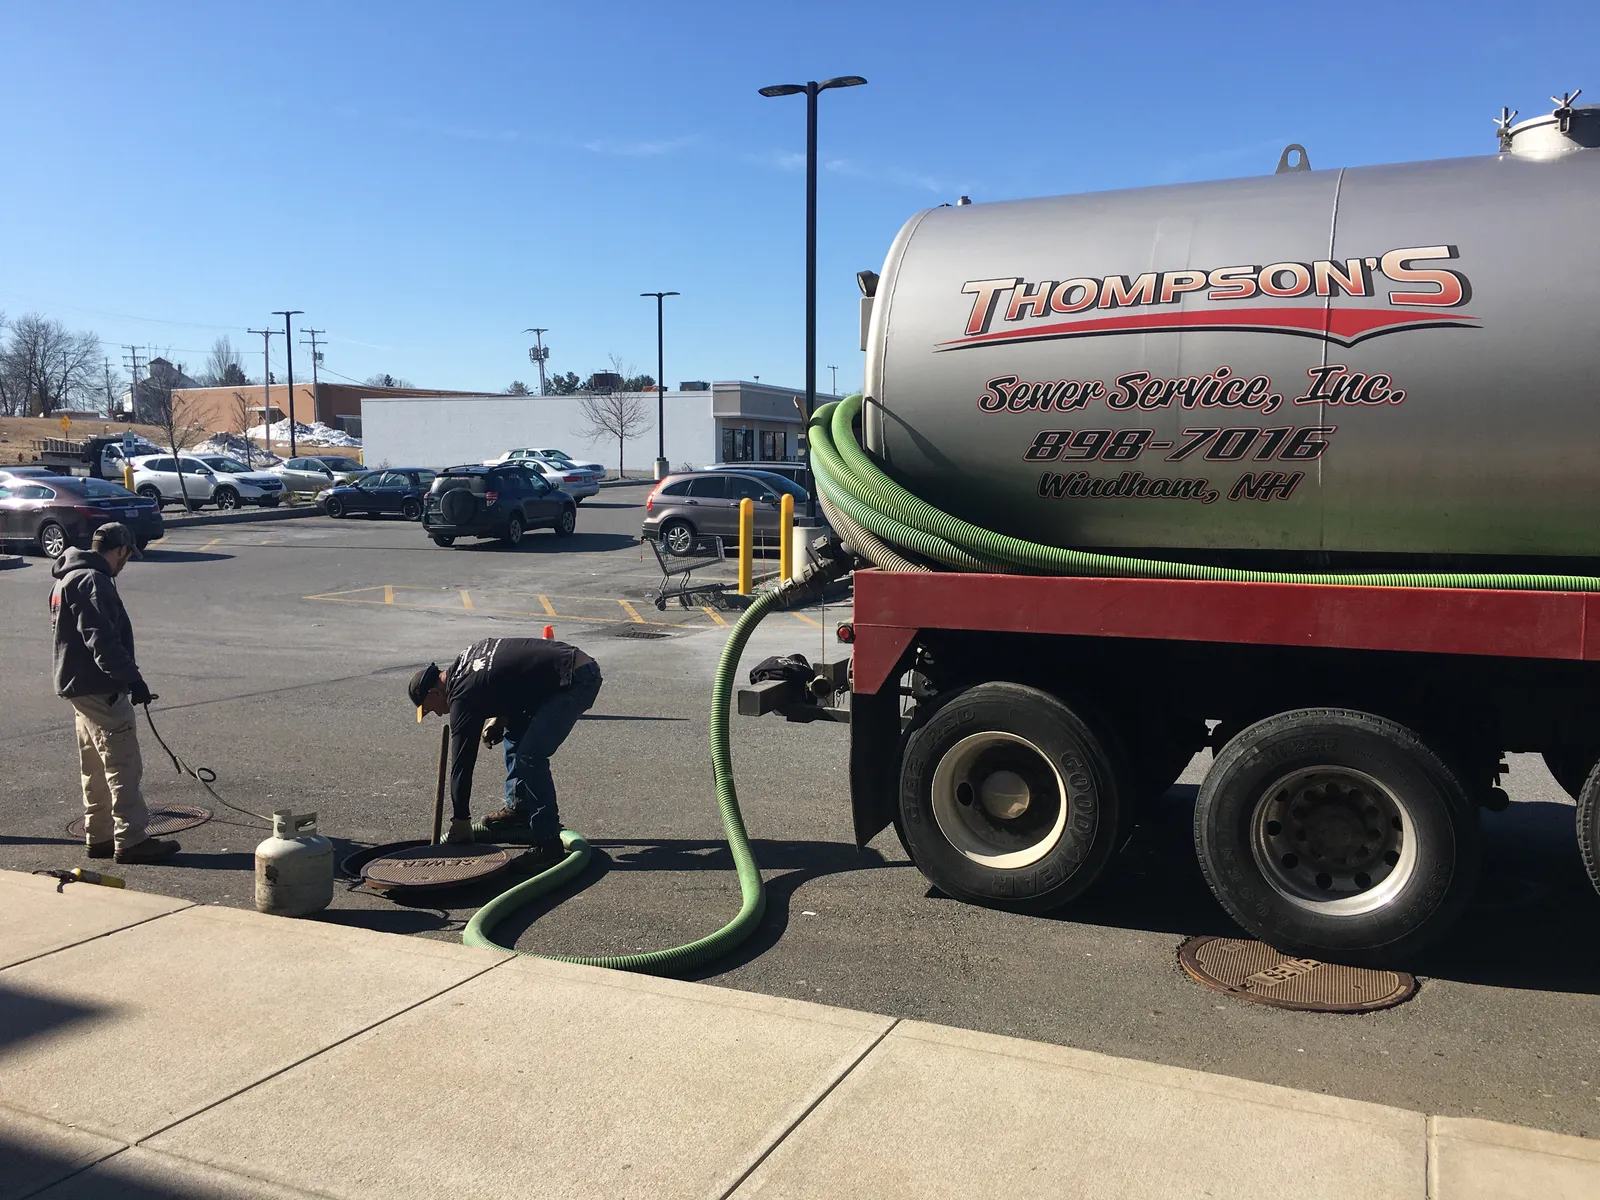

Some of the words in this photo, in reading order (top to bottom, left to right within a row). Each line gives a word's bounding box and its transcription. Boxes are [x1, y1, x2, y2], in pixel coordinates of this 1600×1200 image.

[961, 245, 1471, 336] THOMPSON'S
[978, 374, 1104, 413] Sewer
[1106, 366, 1282, 415] Service,
[1293, 364, 1406, 407] Inc.
[1022, 425, 1337, 463] 898-7016
[1036, 469, 1220, 505] Windham,
[1229, 472, 1306, 502] NH
[991, 749, 1096, 896] GOODYEAR
